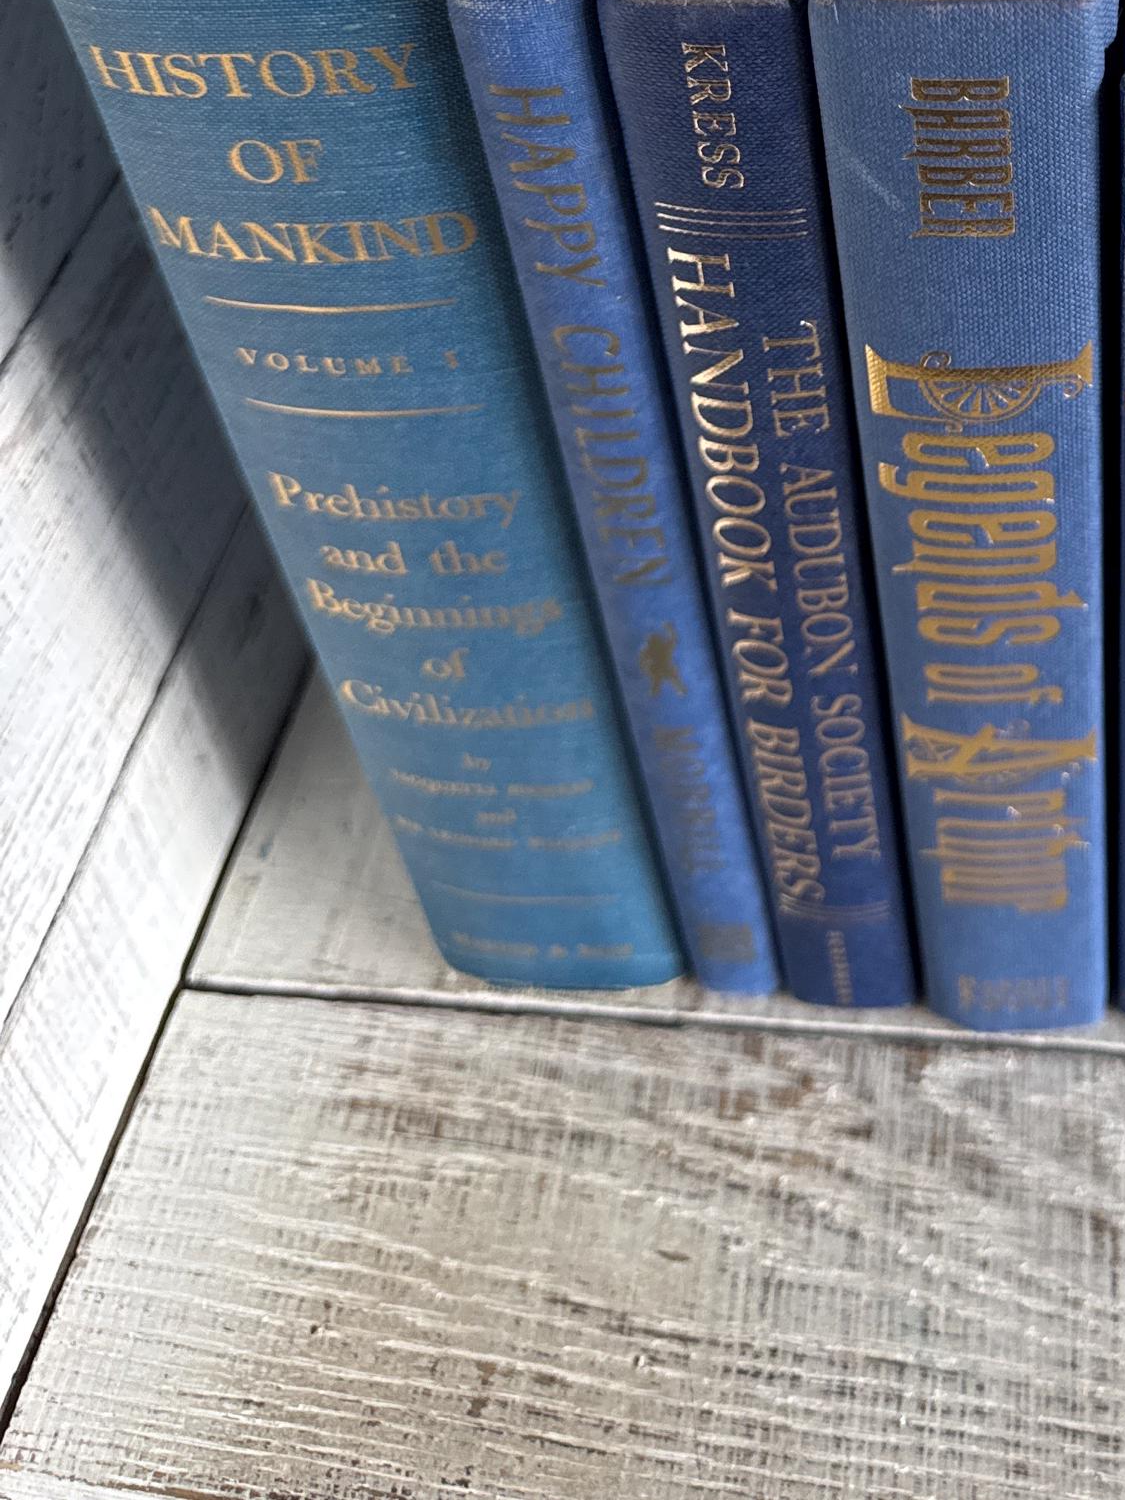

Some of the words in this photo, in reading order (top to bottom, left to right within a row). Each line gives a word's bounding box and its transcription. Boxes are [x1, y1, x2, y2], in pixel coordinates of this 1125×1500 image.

[89, 43, 418, 98] HISTORY
[680, 41, 745, 191] KRESS
[227, 138, 324, 185] OF
[898, 76, 1016, 239] BARBER
[149, 205, 478, 265] MANKIND
[236, 347, 414, 377] VOLUME
[488, 84, 607, 287] HAPPY
[552, 325, 674, 586] CHILDREN
[763, 319, 831, 437] THE
[667, 247, 778, 593] HANDBOOK
[267, 470, 522, 529] Prehistory
[864, 340, 1093, 646] Legends
[320, 540, 408, 576] and
[430, 540, 508, 576] the
[779, 461, 858, 676] AUDUBON
[306, 577, 563, 638] Beginnings
[421, 648, 470, 679] of
[726, 606, 794, 708] FOR
[924, 663, 1063, 704] of
[340, 678, 594, 729] Civilization
[747, 716, 826, 903] BIRDERS
[810, 693, 881, 861] SOCIETY
